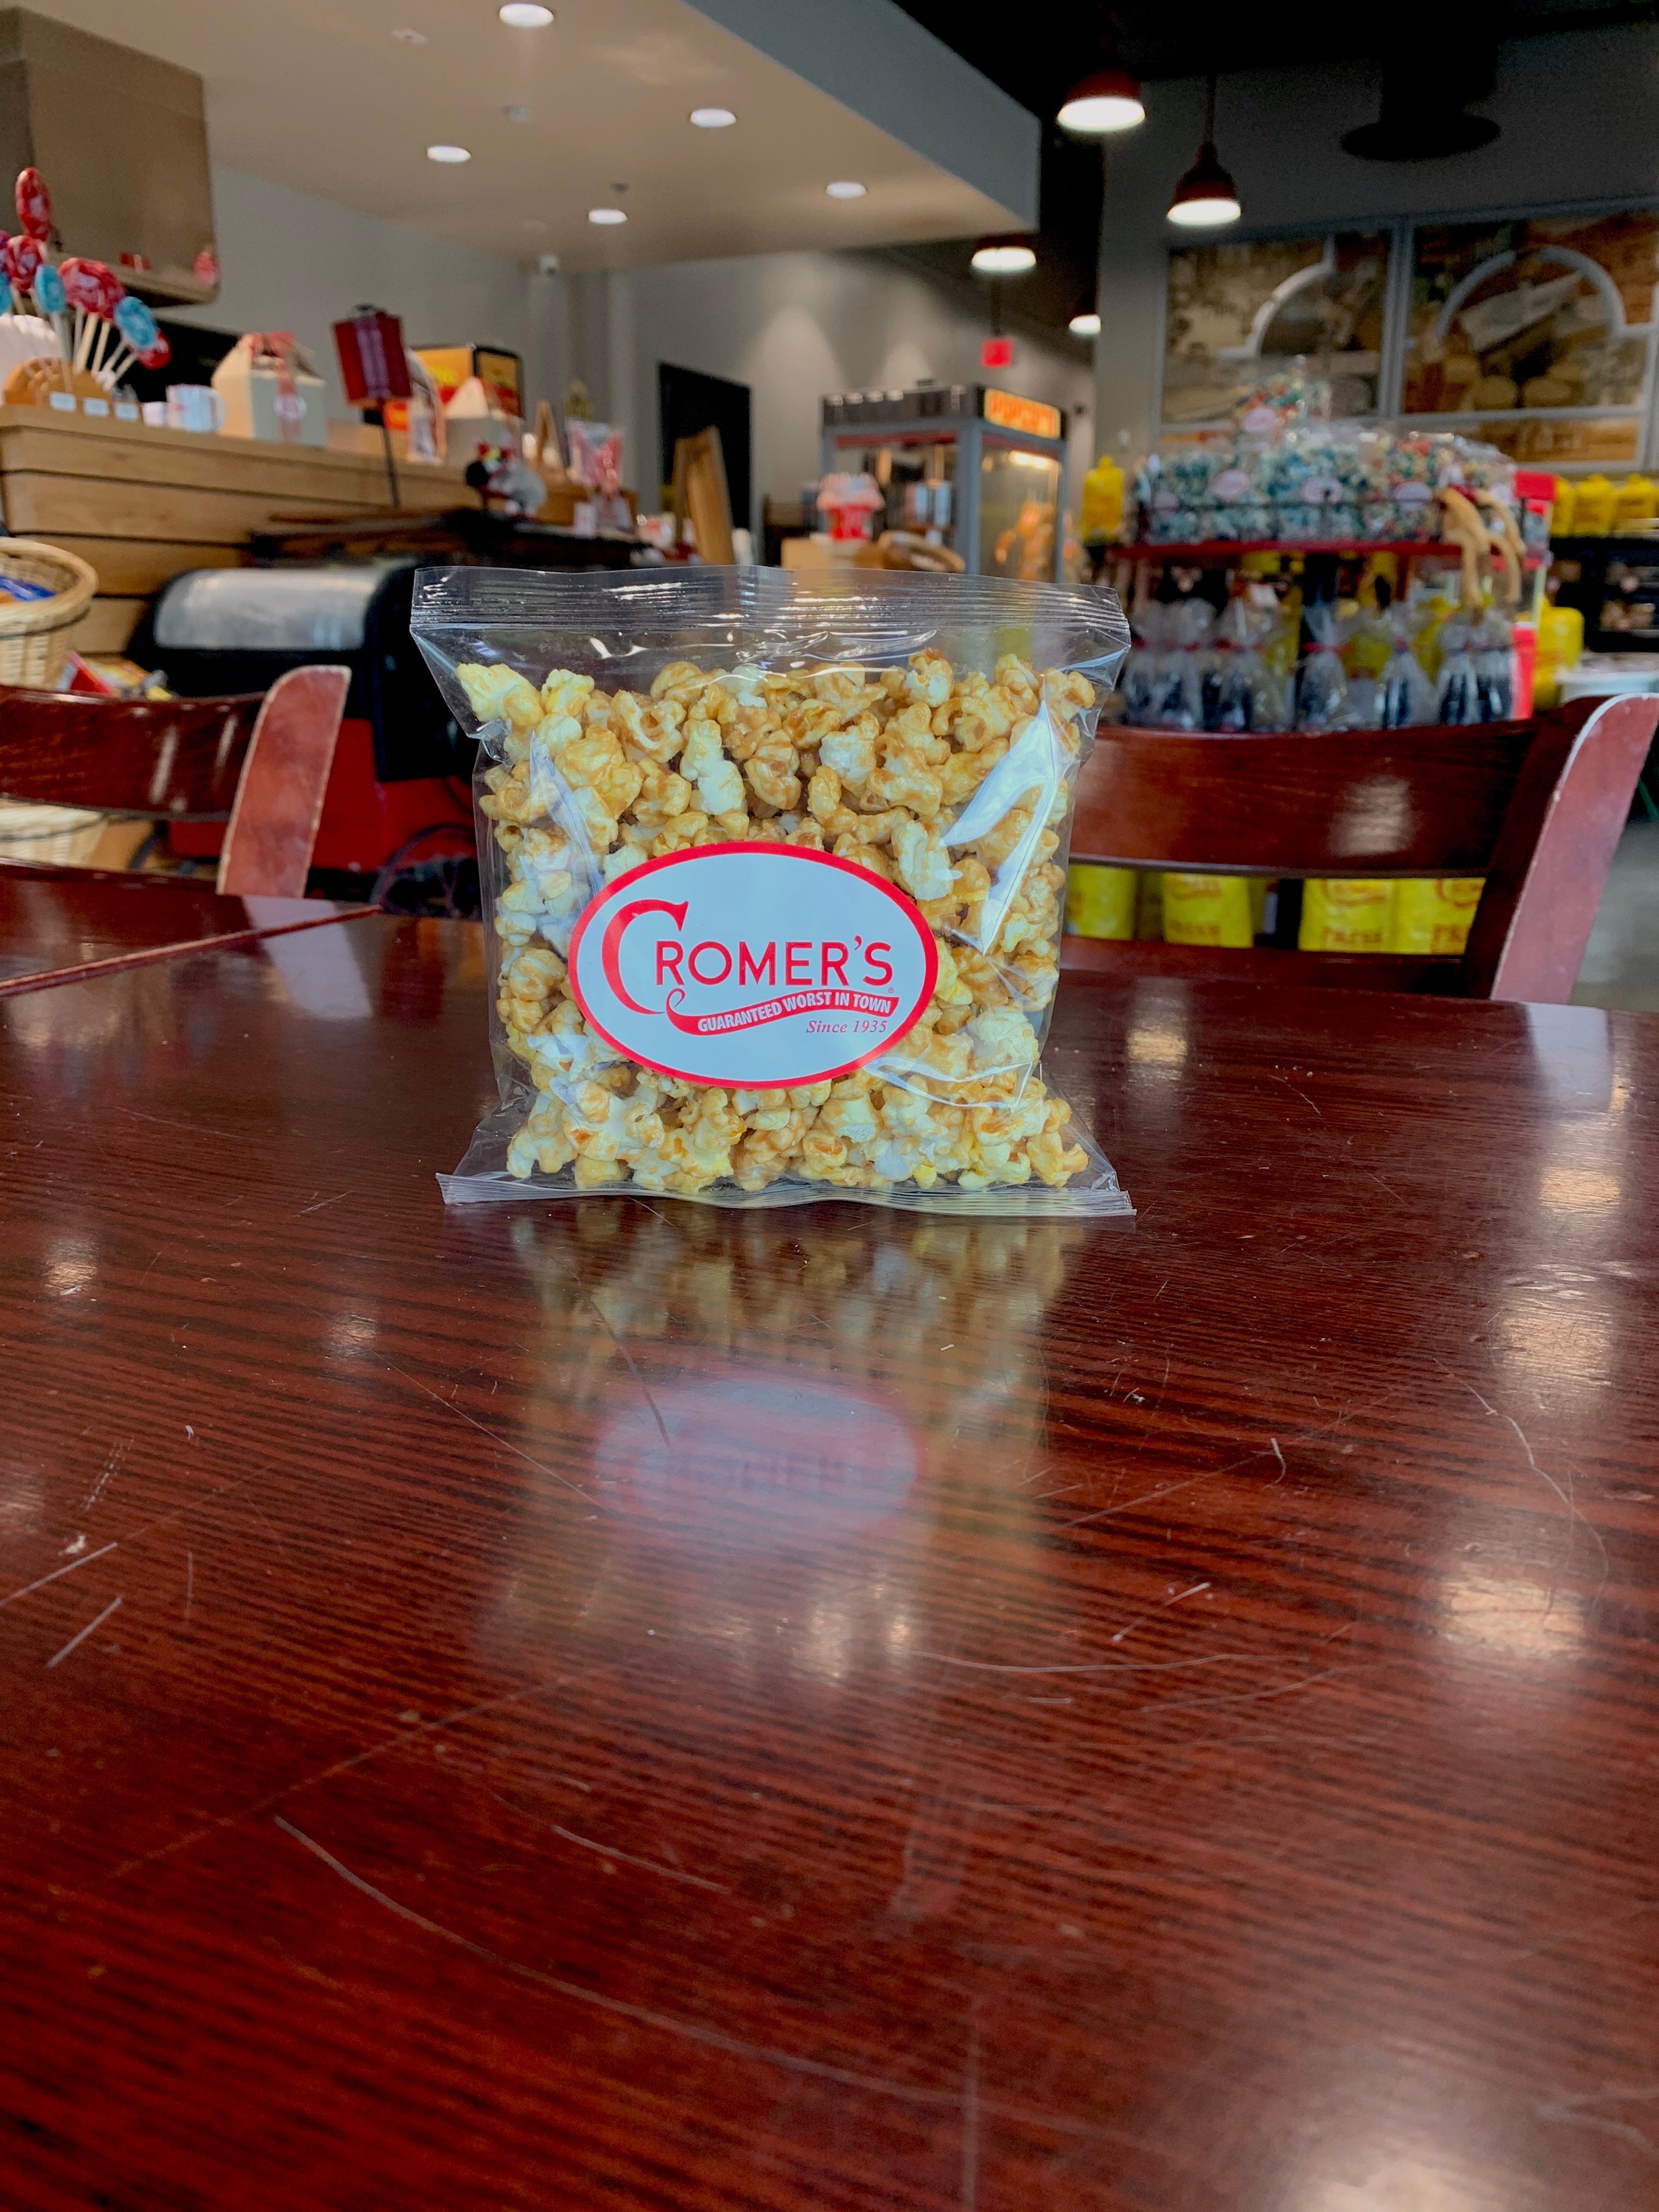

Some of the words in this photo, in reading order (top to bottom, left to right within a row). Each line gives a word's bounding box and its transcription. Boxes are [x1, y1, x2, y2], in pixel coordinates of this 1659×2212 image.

[601, 899, 893, 1015] CROMER'S
[697, 1001, 782, 1032] GUARANTEED
[783, 991, 832, 1011] WORST
[834, 992, 850, 1007] IN
[853, 994, 891, 1014] TOWN
[805, 1019, 847, 1034] Since
[853, 1019, 887, 1034] 1935
